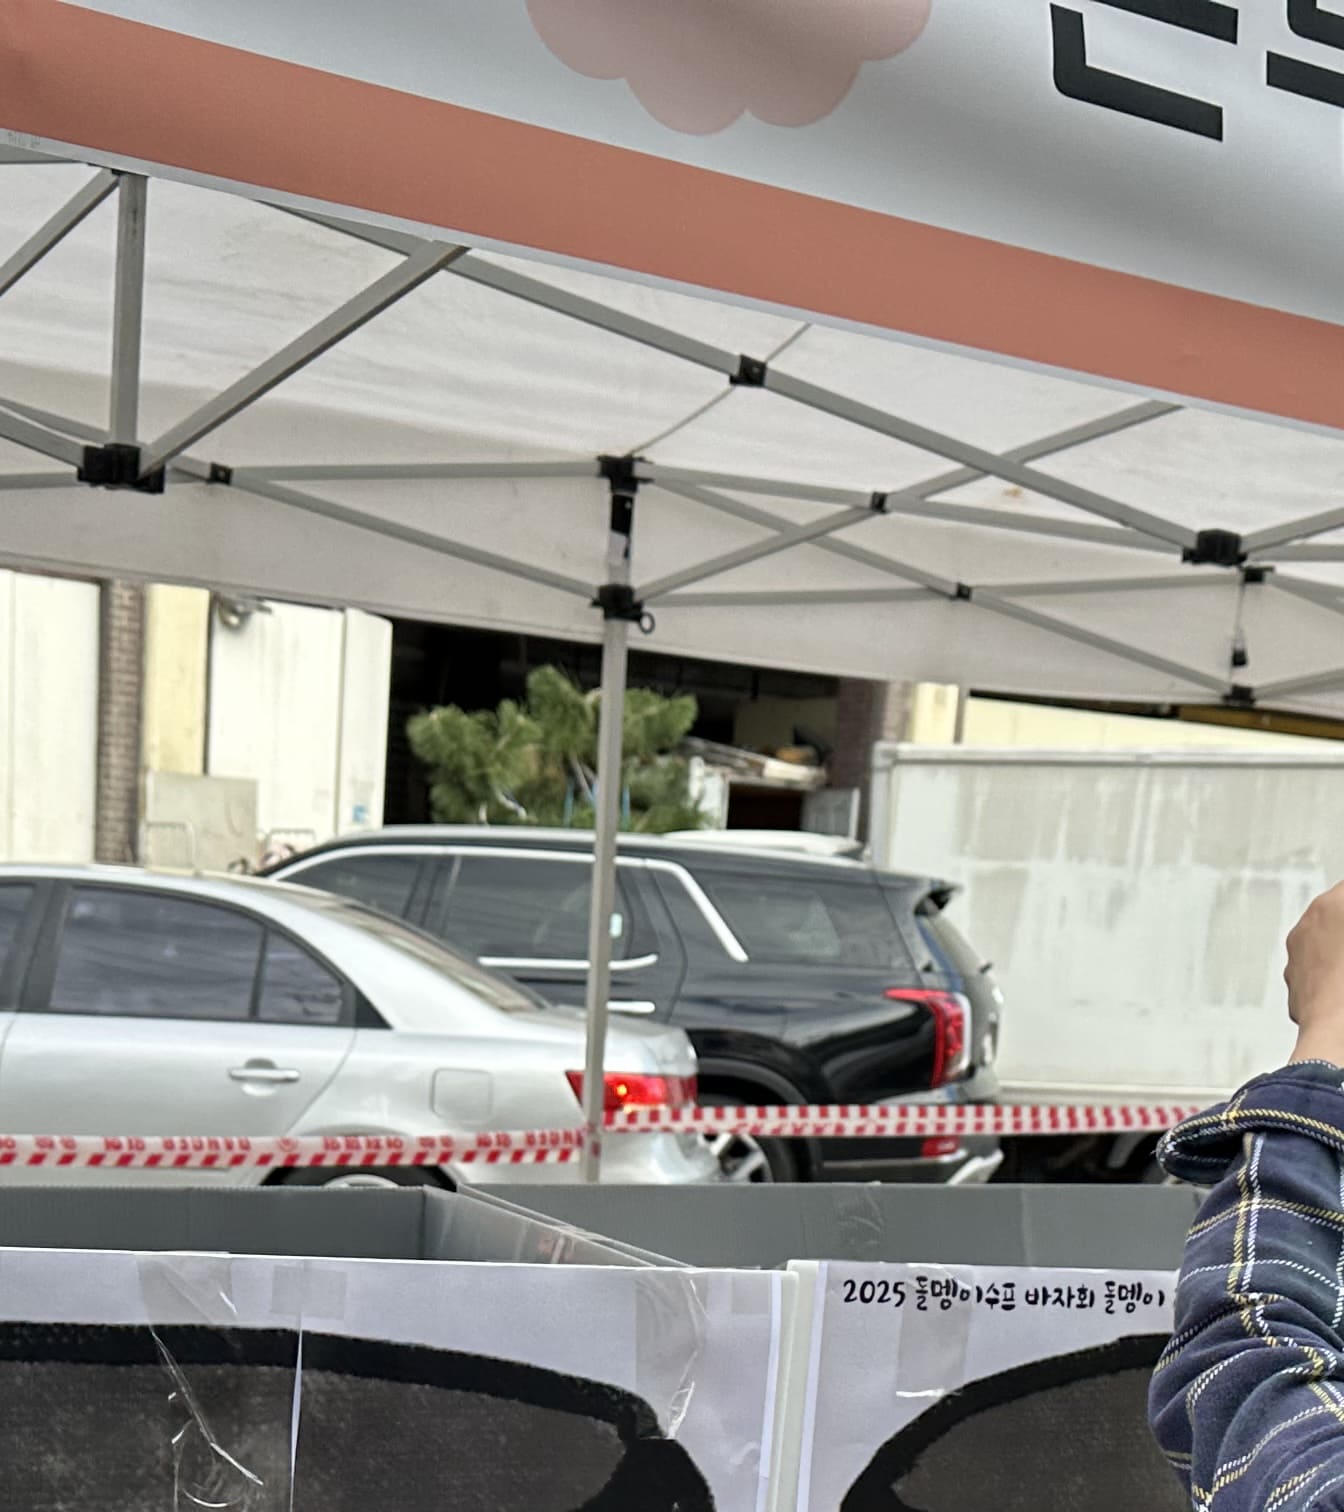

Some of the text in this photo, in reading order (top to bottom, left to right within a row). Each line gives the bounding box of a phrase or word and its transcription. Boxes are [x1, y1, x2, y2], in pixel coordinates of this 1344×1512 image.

[843, 1275, 1166, 1314] 2025 돌멩이수프 바자회 돌멩이
